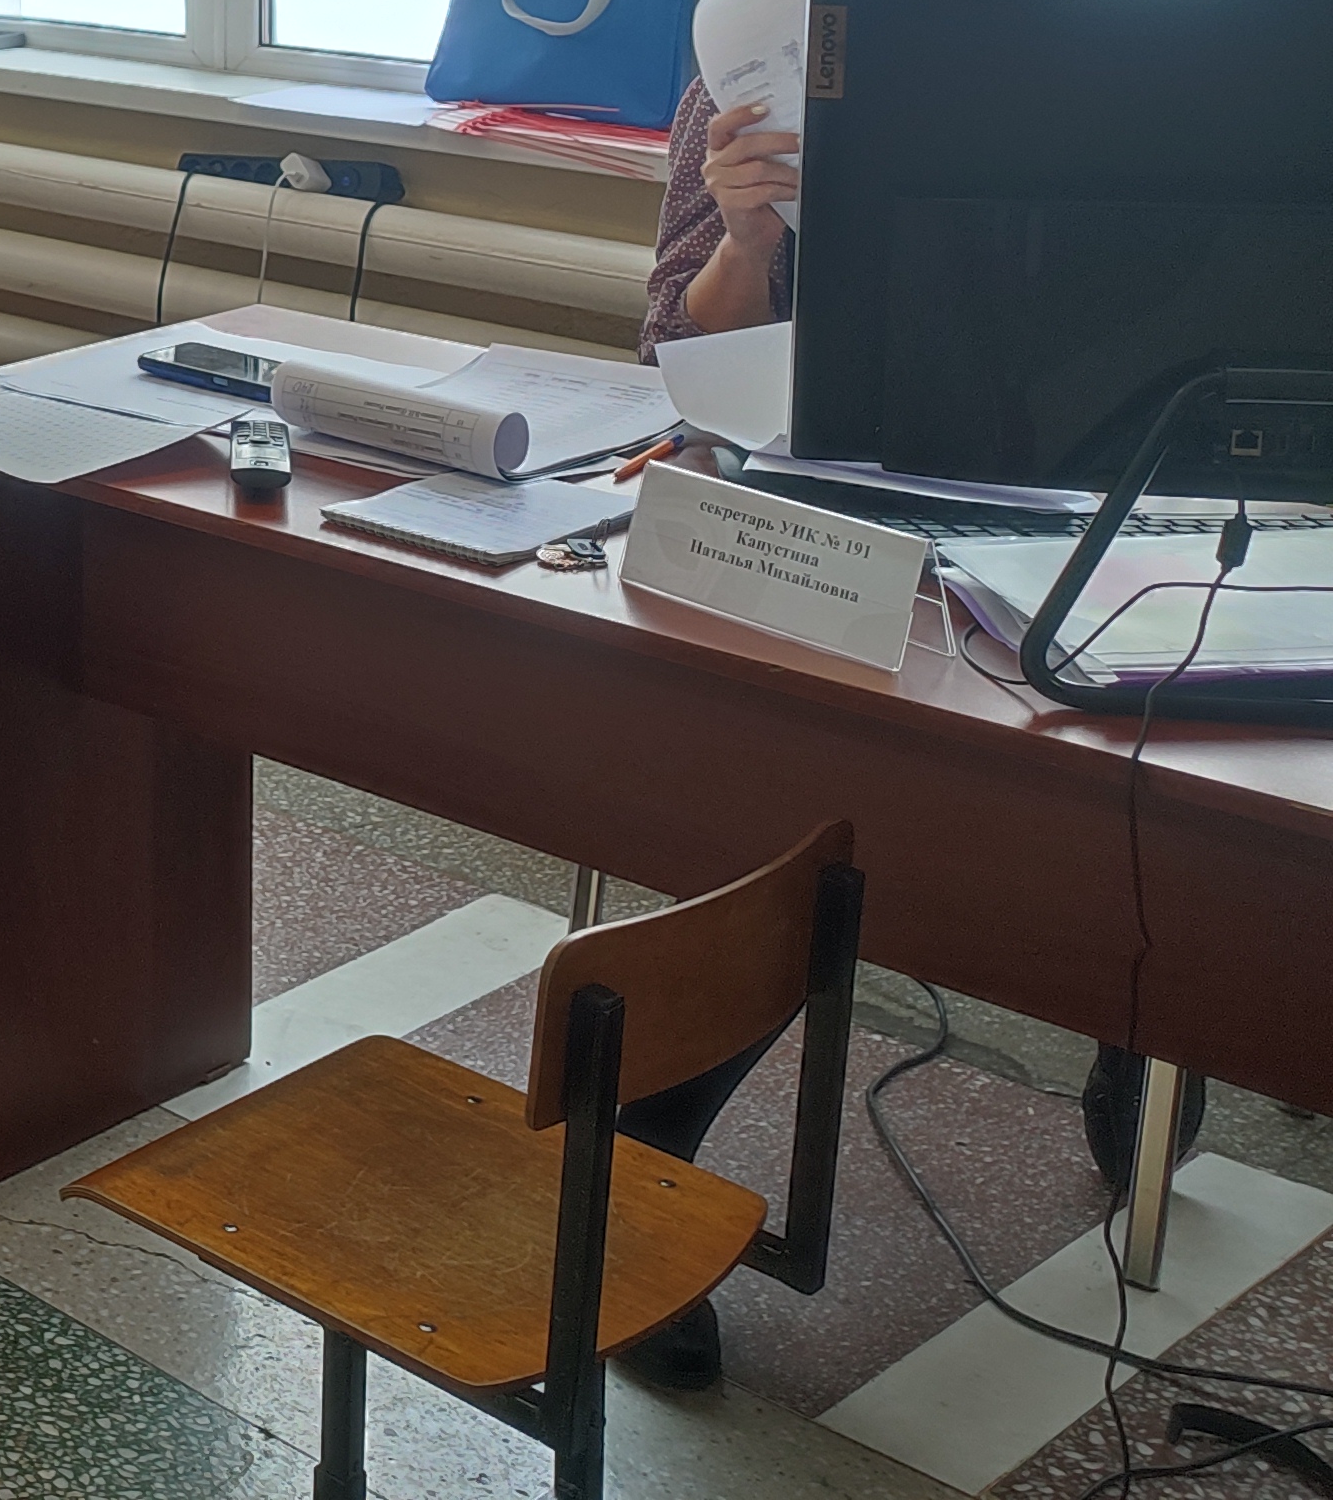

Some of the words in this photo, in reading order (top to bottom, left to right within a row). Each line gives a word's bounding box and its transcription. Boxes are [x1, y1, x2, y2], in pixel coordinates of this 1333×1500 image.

[815, 12, 837, 90] Lenovo
[699, 500, 775, 532] секретарь
[779, 519, 820, 545] УИК
[820, 532, 841, 550] №
[845, 539, 872, 560] 191
[736, 530, 820, 568] Капустина
[690, 538, 754, 571] Наталья
[756, 558, 860, 604] Михайловна
